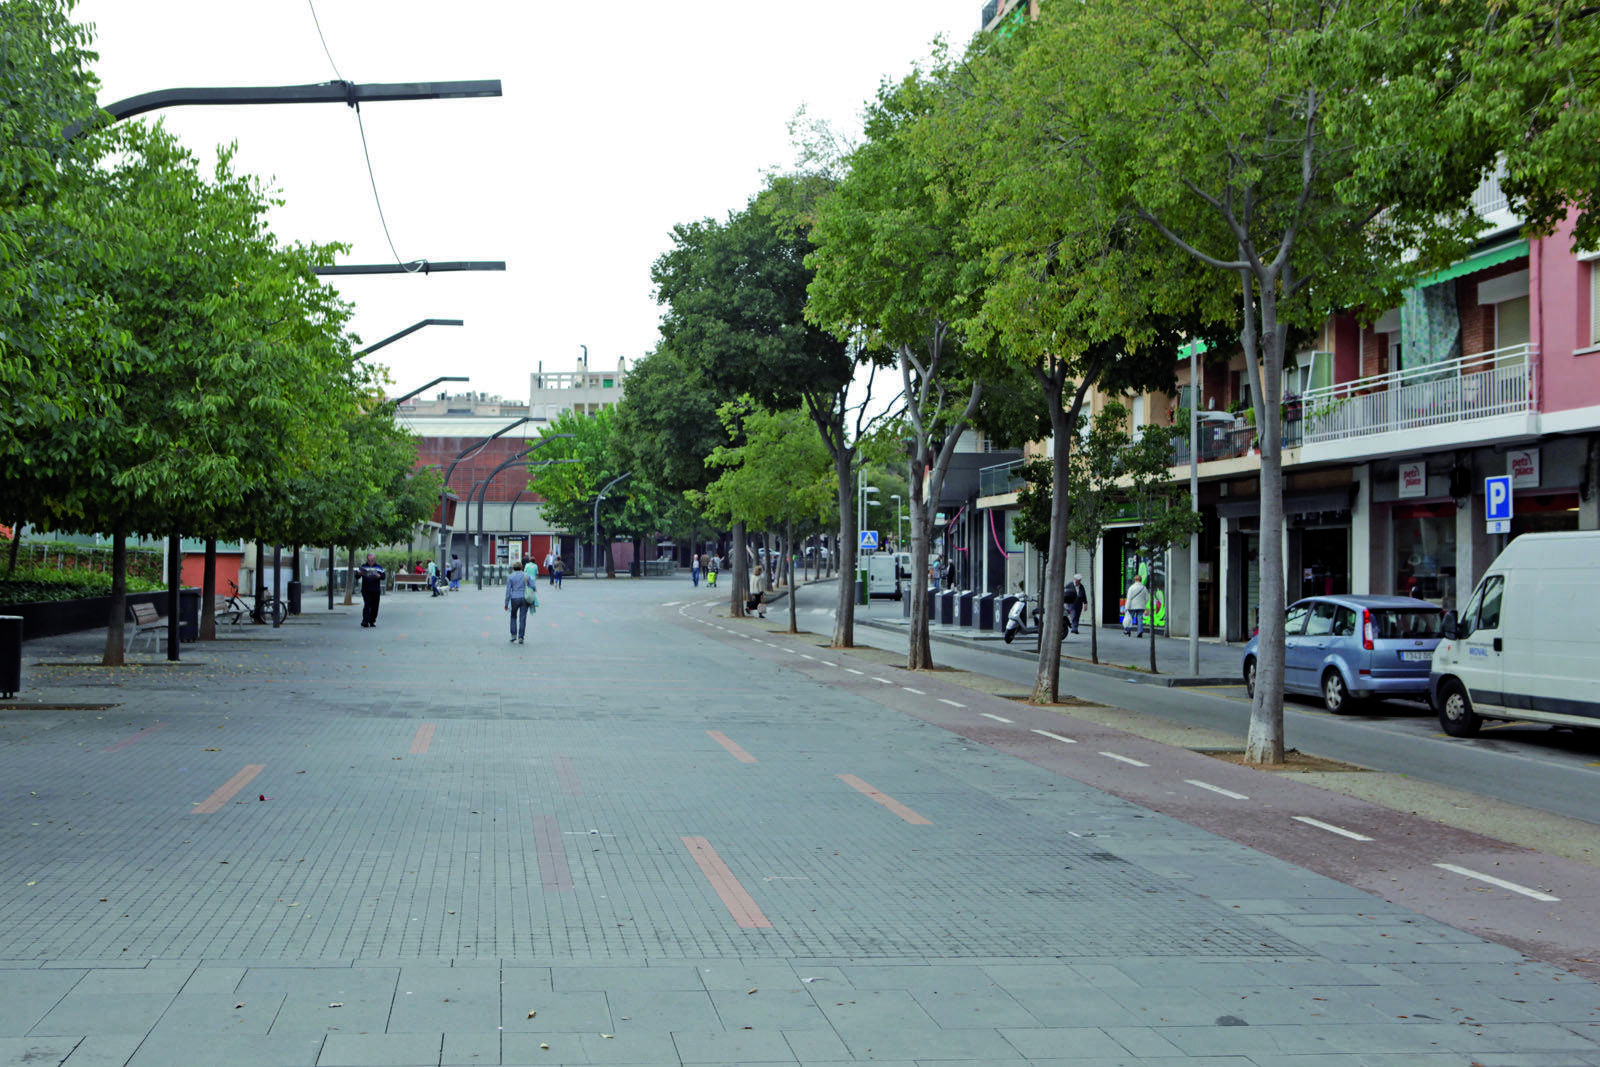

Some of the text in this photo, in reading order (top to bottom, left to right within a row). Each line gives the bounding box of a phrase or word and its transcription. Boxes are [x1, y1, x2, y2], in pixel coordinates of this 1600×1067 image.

[1512, 458, 1530, 469] pets
[1514, 467, 1534, 478] place
[1405, 478, 1421, 488] place
[1490, 481, 1506, 516] P
